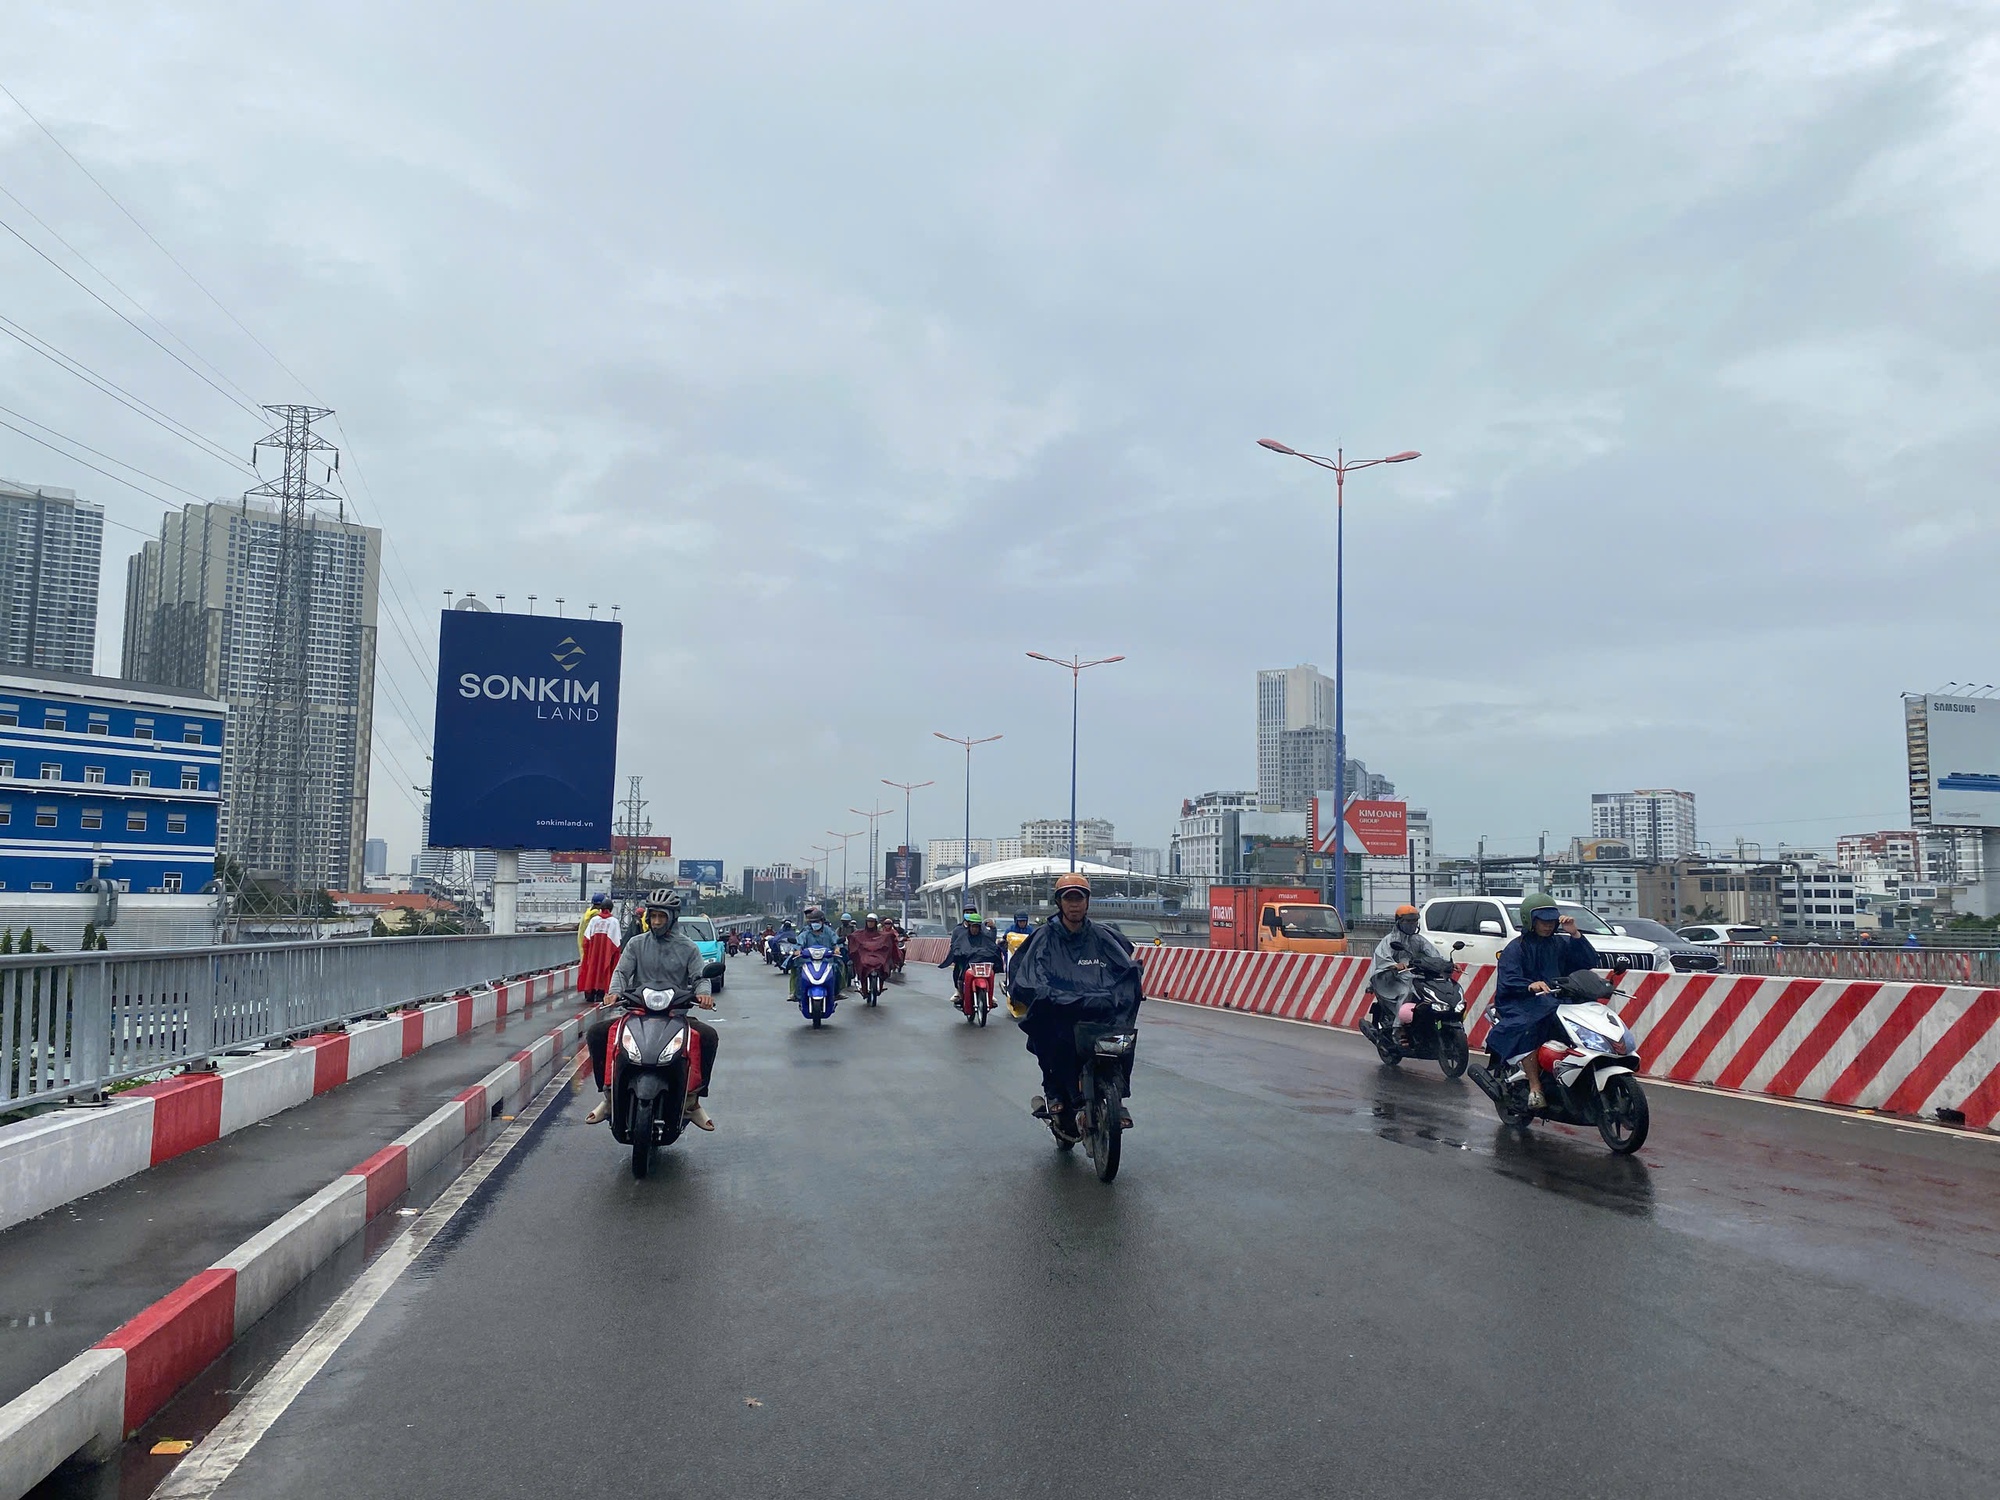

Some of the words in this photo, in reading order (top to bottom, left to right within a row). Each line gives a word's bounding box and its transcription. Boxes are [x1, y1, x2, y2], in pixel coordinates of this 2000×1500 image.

[459, 673, 600, 705] SONKIM
[1933, 702, 1976, 713] SAMSUNG
[537, 705, 599, 722] LAND
[1359, 809, 1375, 817] KIM
[1376, 810, 1402, 818] OANH
[536, 819, 594, 827] sonkimland.vn
[1056, 843, 1070, 852] PN
